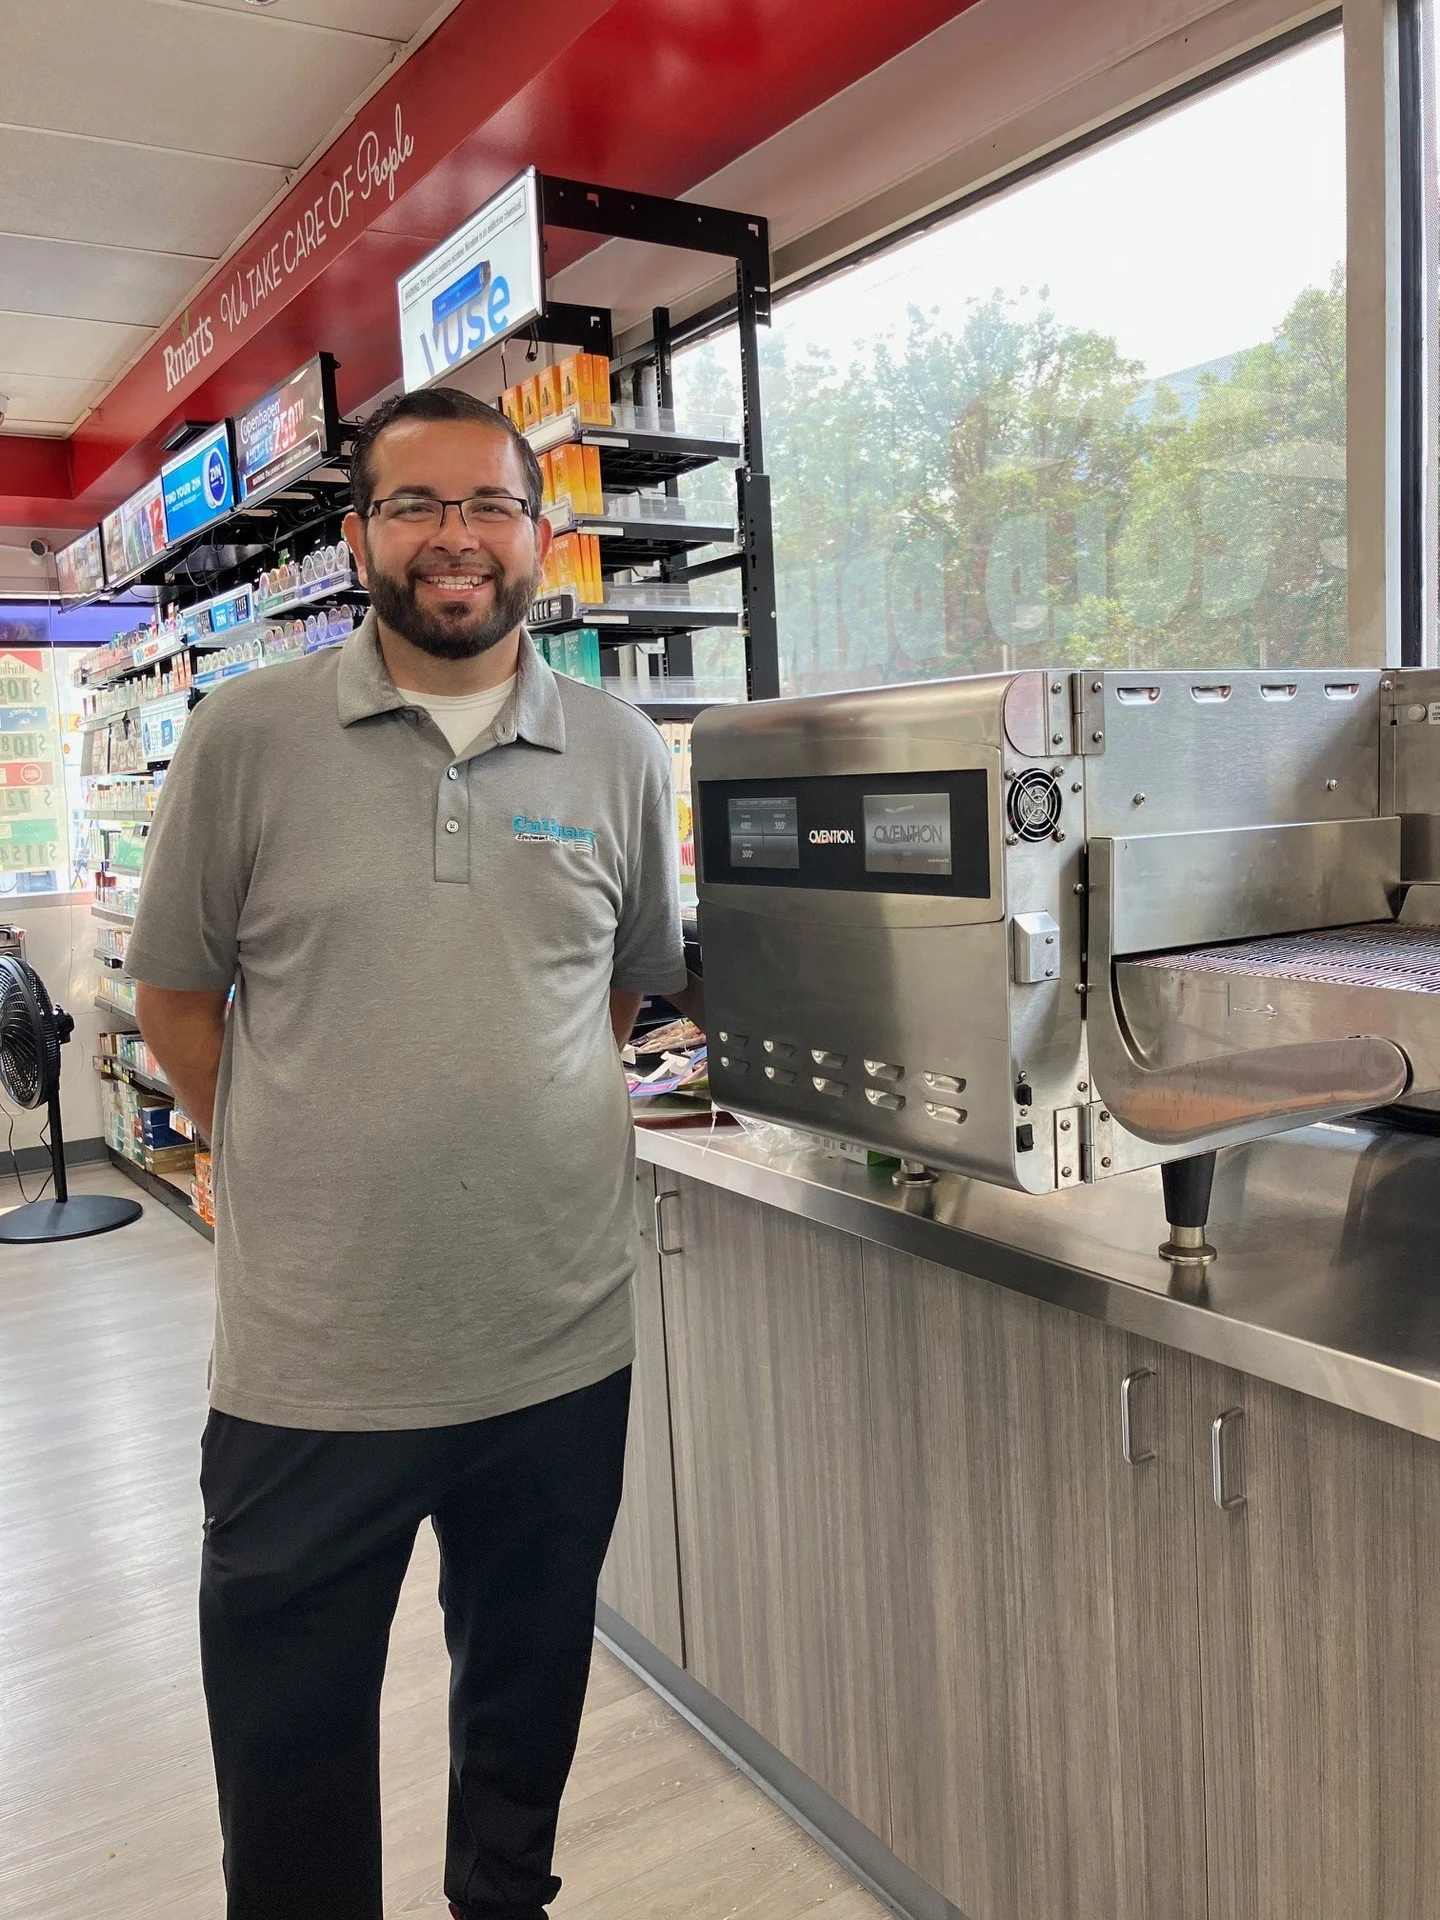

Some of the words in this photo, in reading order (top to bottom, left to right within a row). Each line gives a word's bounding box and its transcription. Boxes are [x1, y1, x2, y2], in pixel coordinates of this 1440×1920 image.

[163, 316, 214, 392] Rmarts
[247, 243, 282, 309] TAKE
[283, 196, 326, 274] CARE
[328, 166, 354, 228] OF
[356, 103, 415, 201] People
[240, 398, 281, 445] Copenhagen
[874, 824, 943, 844] OVENTION
